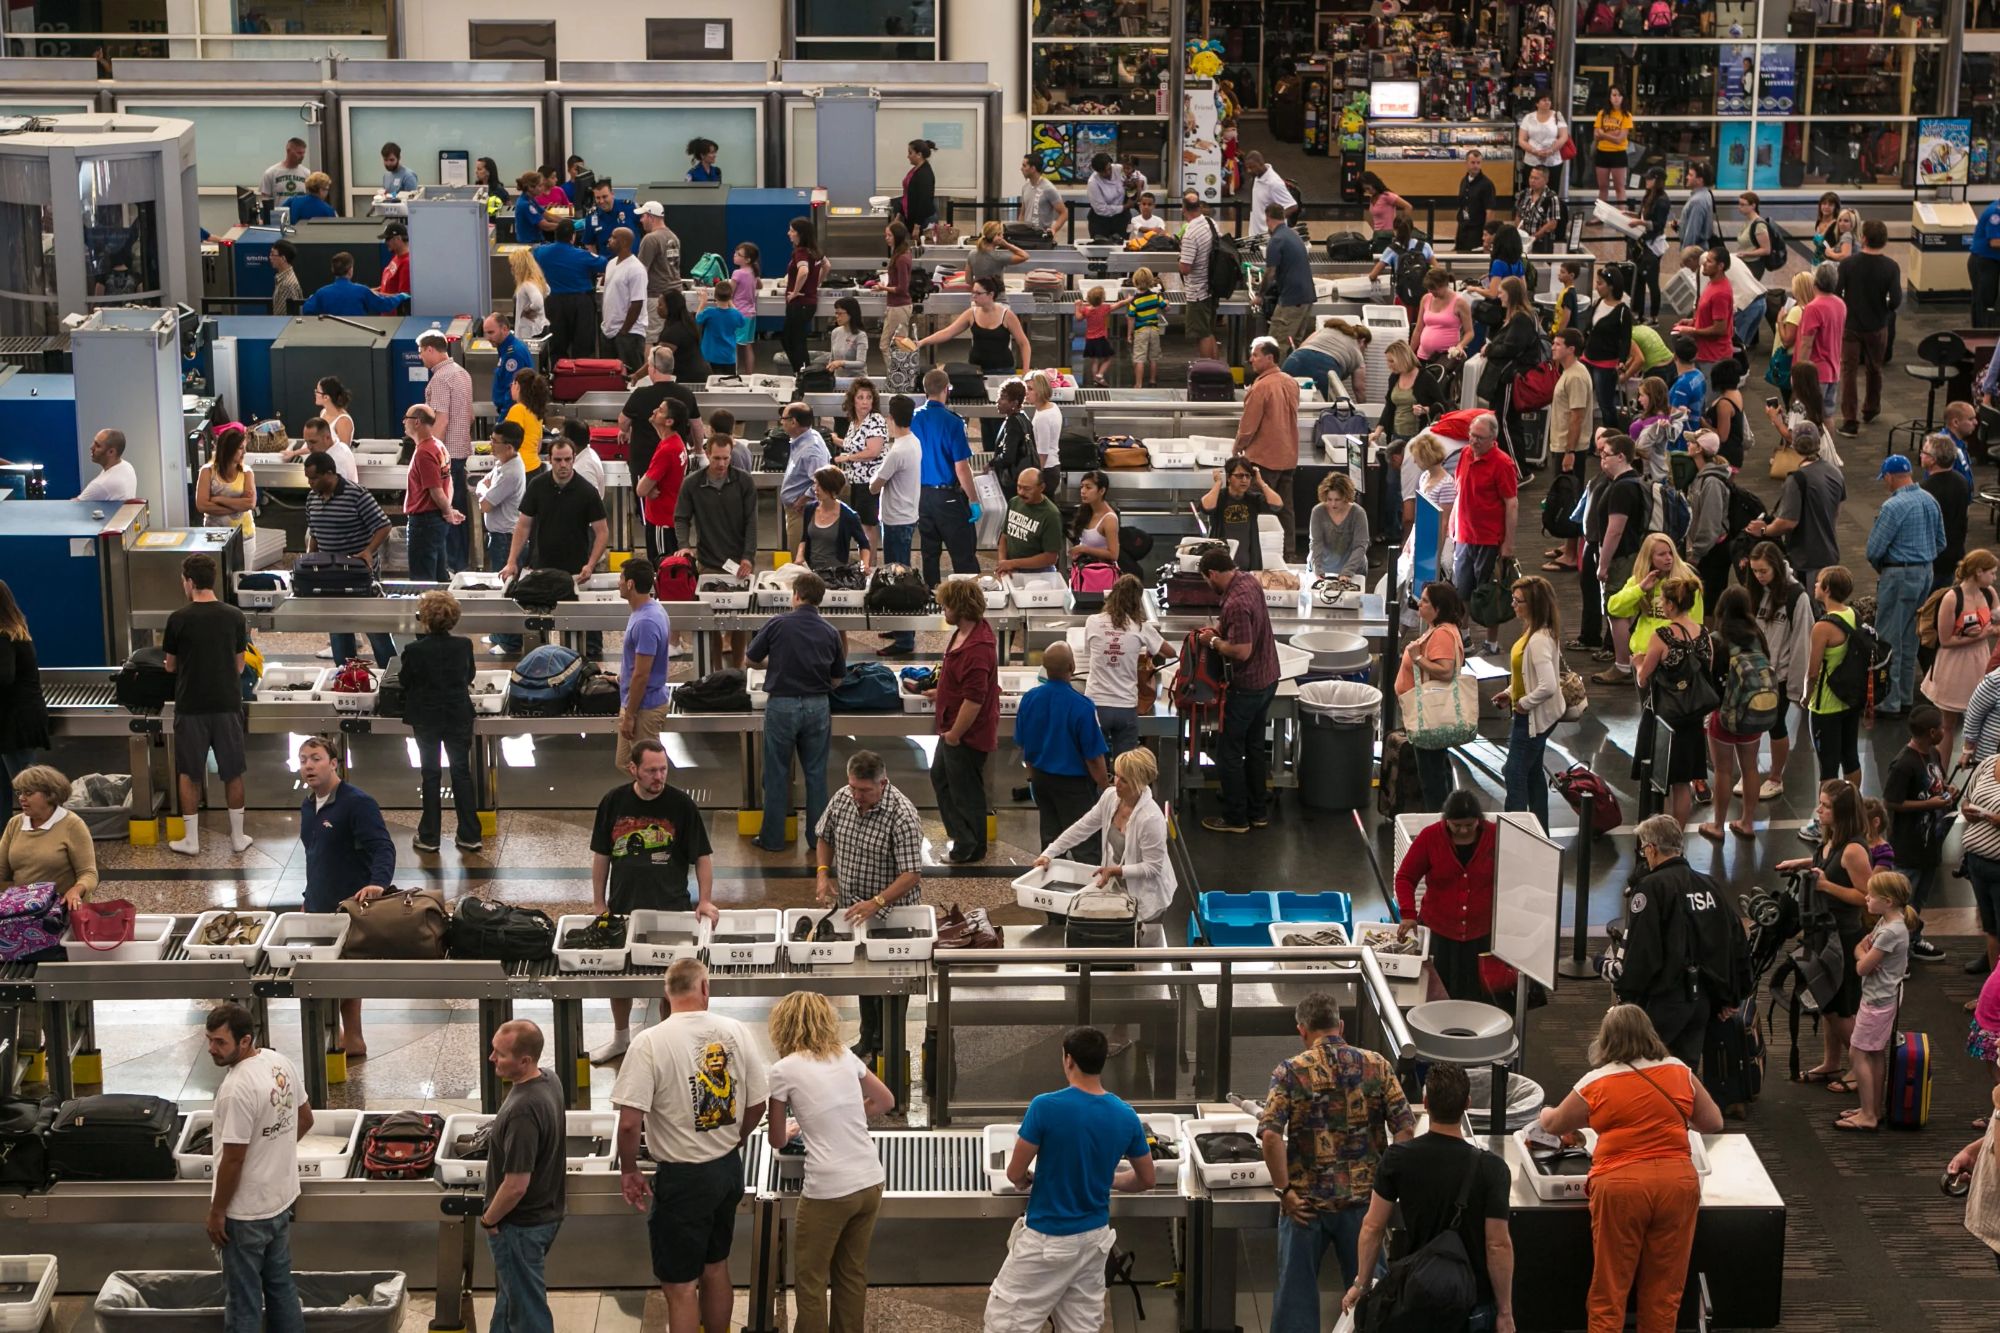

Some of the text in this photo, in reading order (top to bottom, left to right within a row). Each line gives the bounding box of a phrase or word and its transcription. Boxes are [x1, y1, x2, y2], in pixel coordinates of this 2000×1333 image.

[1006, 522, 1029, 542] STATE
[1033, 895, 1054, 906] A05
[1686, 890, 1717, 911] TSA
[651, 950, 674, 961] A87
[730, 950, 753, 959] C06
[810, 948, 833, 956] A95
[888, 946, 911, 955] B32
[580, 957, 602, 966] A47
[1230, 1169, 1255, 1181] C90
